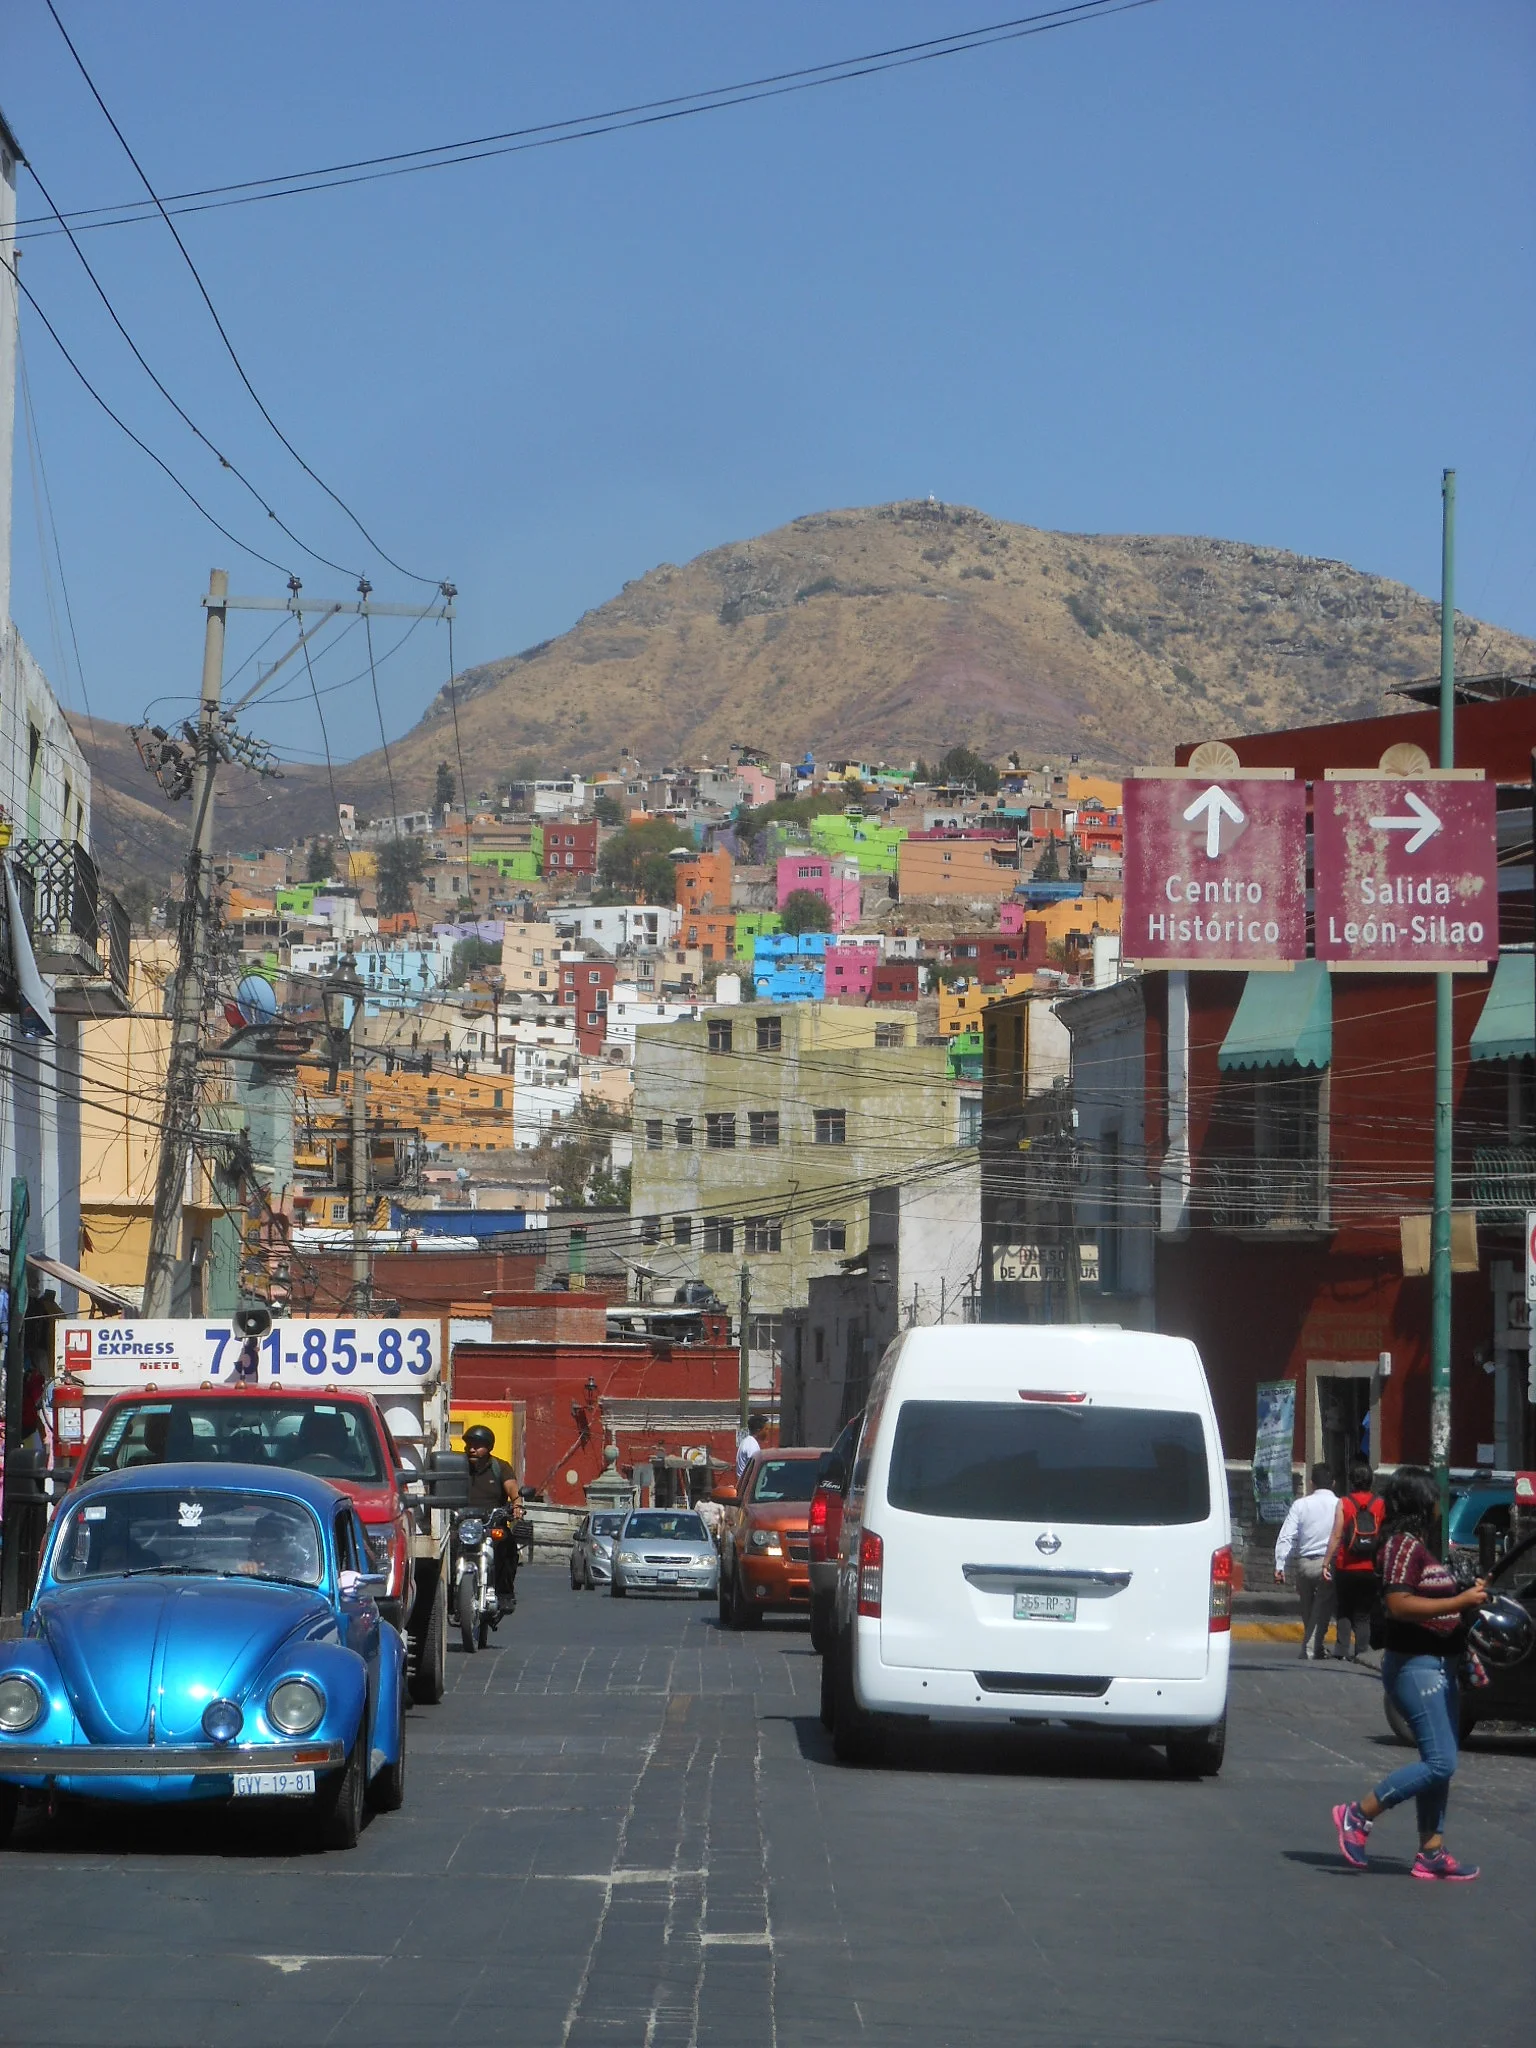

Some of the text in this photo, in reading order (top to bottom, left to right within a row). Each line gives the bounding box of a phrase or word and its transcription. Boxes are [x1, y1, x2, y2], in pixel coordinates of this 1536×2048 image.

[1165, 874, 1262, 904] Centro
[1360, 876, 1450, 905] Salida
[1148, 911, 1280, 943] Histórico
[1329, 913, 1484, 944] León-Silao
[1000, 1266, 1098, 1279] DE LA FRUA
[97, 1328, 134, 1341] GAS
[97, 1342, 175, 1355] EXPRESS
[204, 1327, 433, 1376] 71-85-83
[237, 1774, 311, 1795] GVY-19-81
